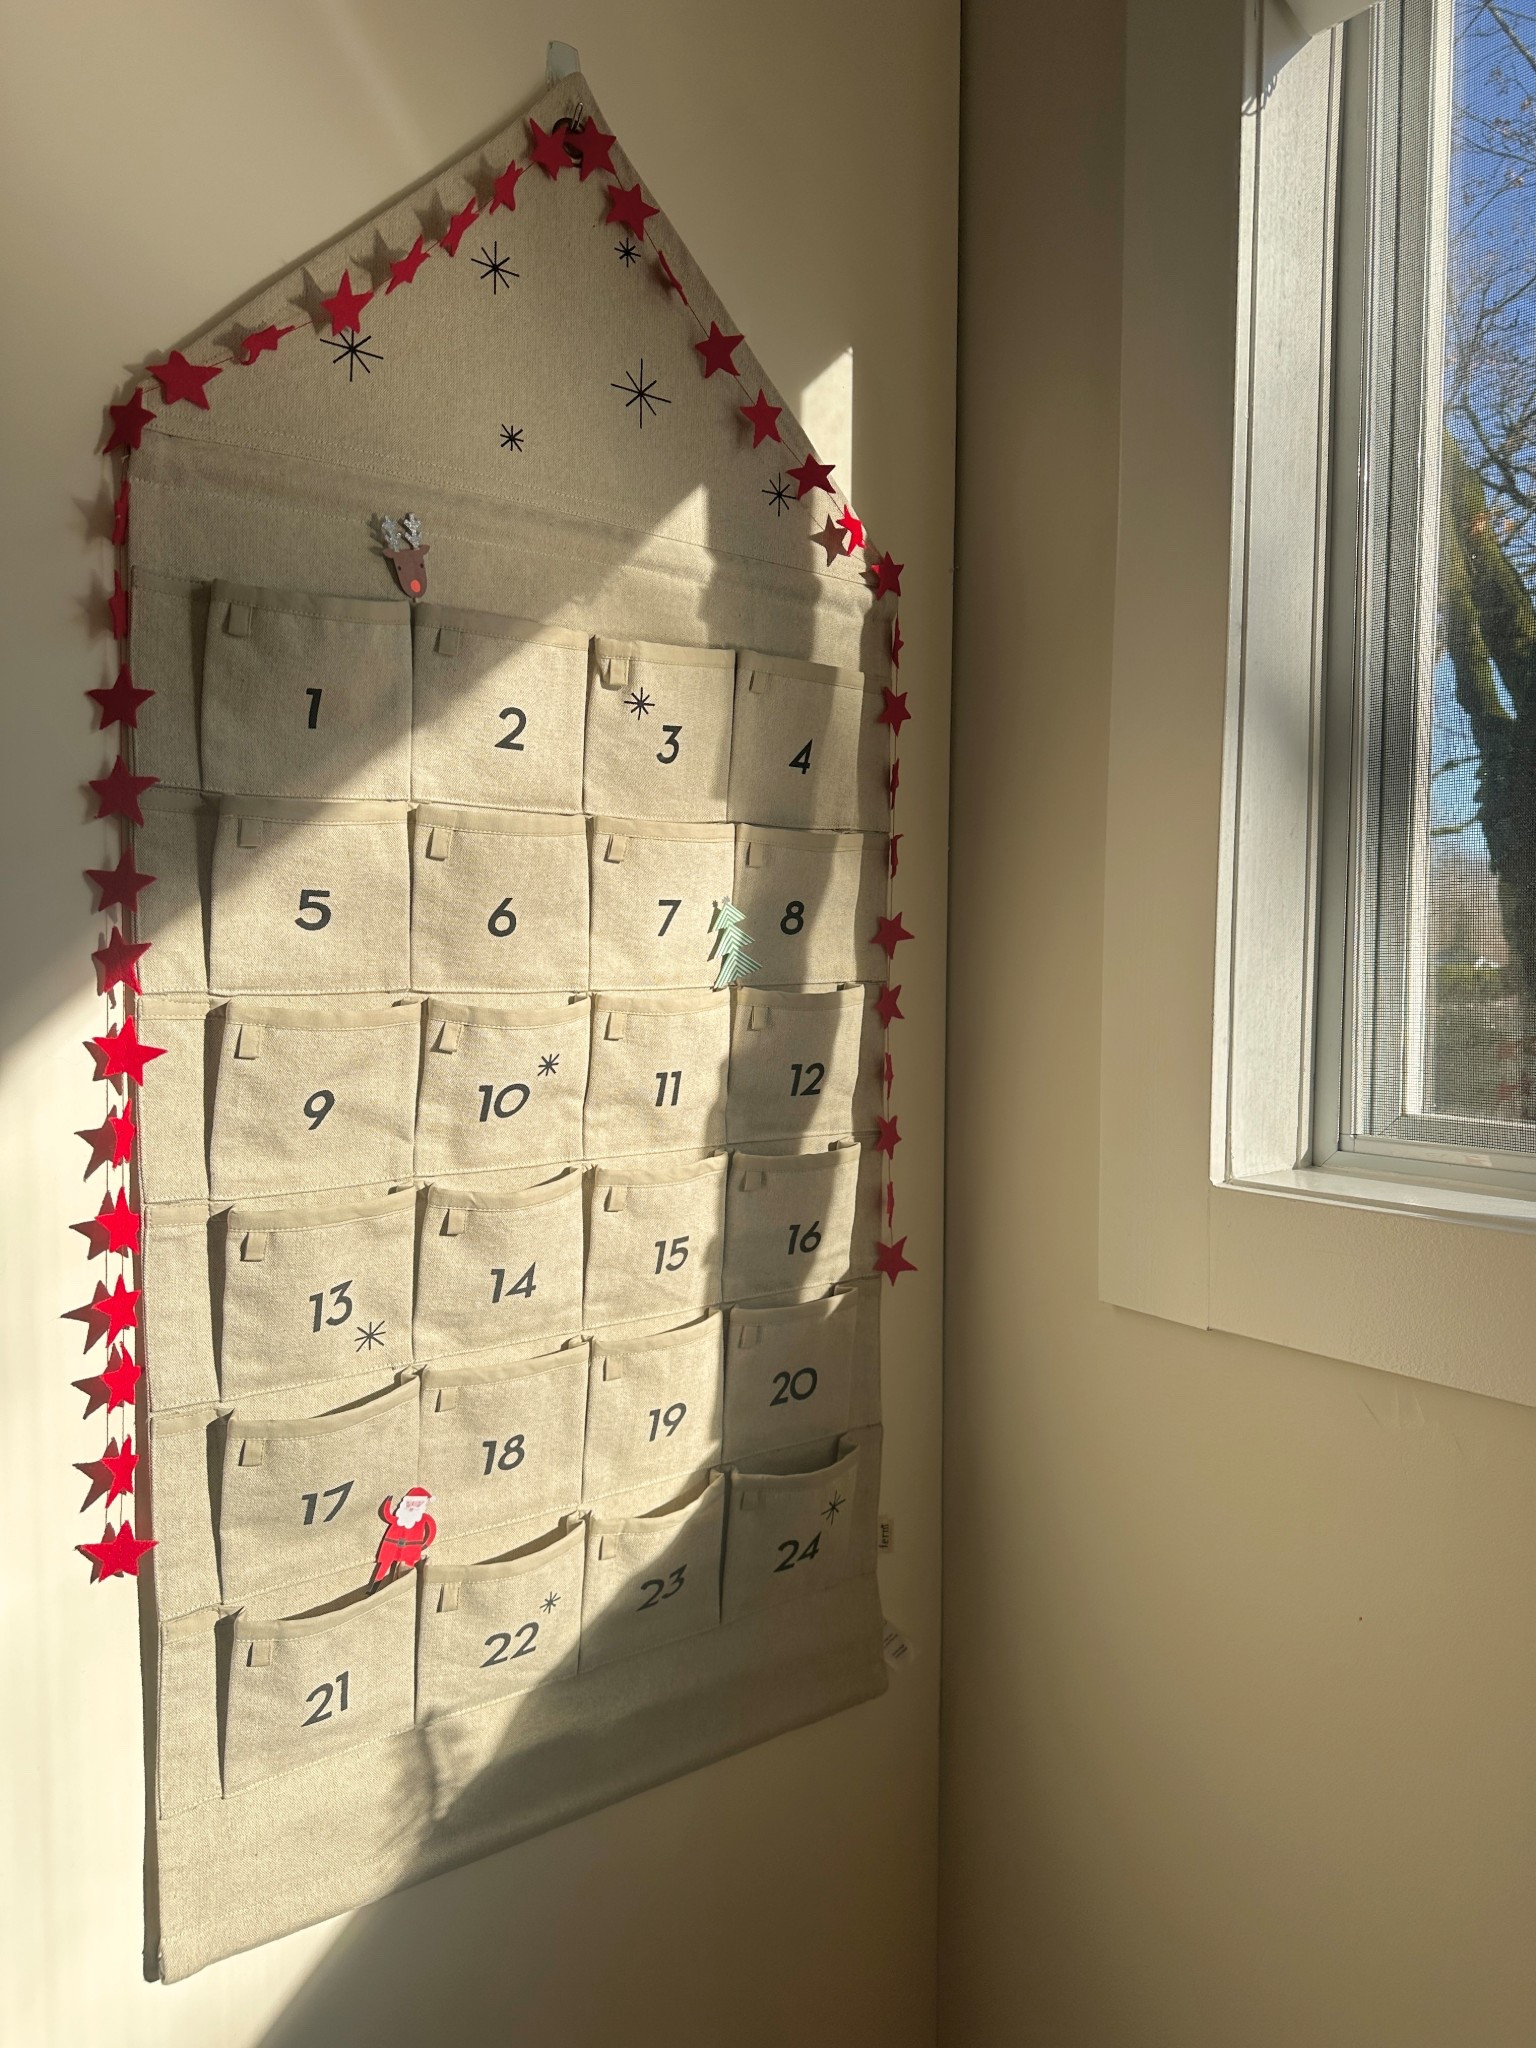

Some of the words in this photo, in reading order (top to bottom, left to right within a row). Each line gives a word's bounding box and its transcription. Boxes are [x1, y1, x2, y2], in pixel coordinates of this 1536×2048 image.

[305, 687, 323, 730] 1
[494, 706, 527, 752] 2
[656, 724, 683, 765] 3
[788, 738, 813, 775] 4
[294, 889, 332, 931] 5
[487, 897, 517, 938] 6
[657, 899, 682, 937] 7
[779, 900, 805, 936] 8
[655, 1070, 682, 1107] 11
[790, 1062, 825, 1097] 12
[303, 1089, 336, 1131] 9
[478, 1083, 531, 1123] 10
[654, 1235, 690, 1275] 15
[787, 1220, 822, 1255] 16
[490, 1261, 537, 1304] 14
[309, 1279, 353, 1333] 13
[769, 1367, 818, 1407] 20
[649, 1402, 687, 1442] 19
[482, 1434, 525, 1476] 18
[301, 1480, 355, 1526] 17
[773, 1532, 822, 1573] 24
[637, 1564, 687, 1611] 23
[480, 1622, 539, 1668] 22
[300, 1670, 349, 1728] 21
